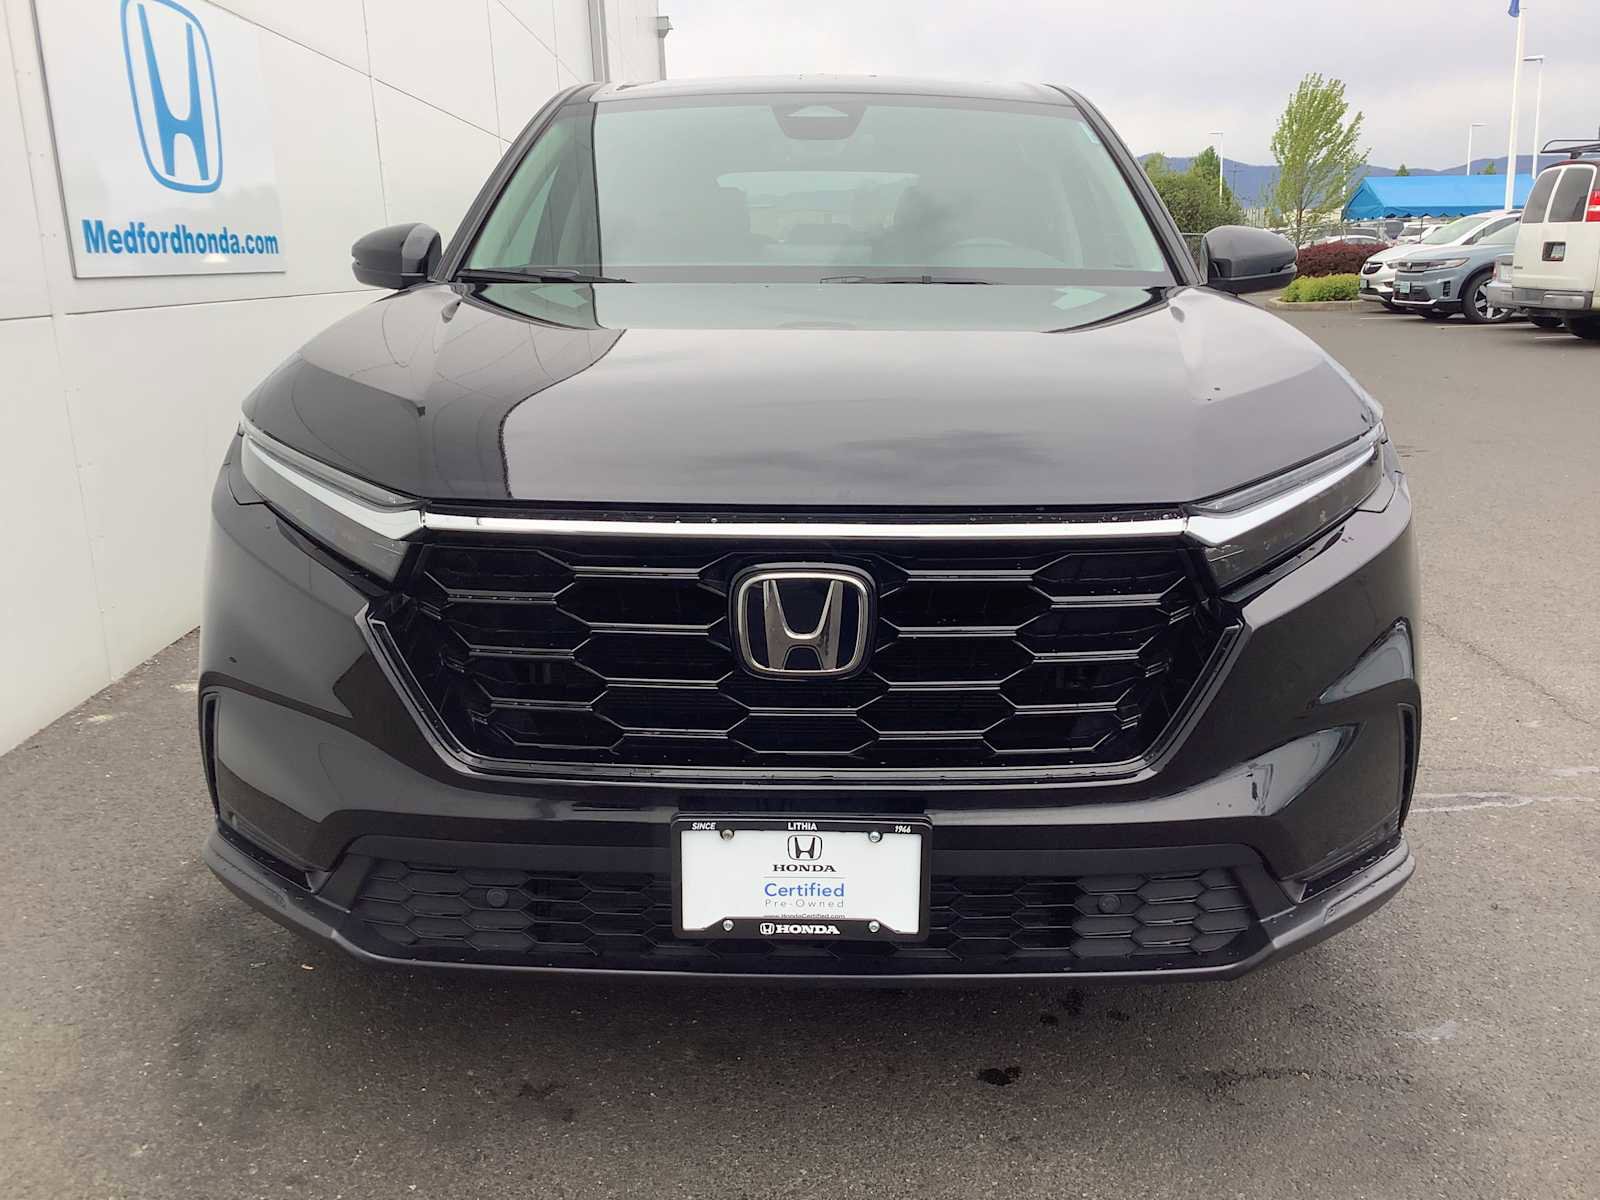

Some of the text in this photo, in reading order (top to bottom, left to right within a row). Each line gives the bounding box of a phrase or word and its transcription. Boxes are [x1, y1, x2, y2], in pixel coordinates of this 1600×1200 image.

[82, 219, 279, 254] Medfordhonda.com
[691, 822, 717, 830] SINCE
[787, 822, 818, 831] LITHIA
[773, 864, 837, 873] HONDA
[764, 882, 845, 897] Certified
[765, 899, 844, 908] Pre-Owned
[775, 924, 841, 935] HONDA
